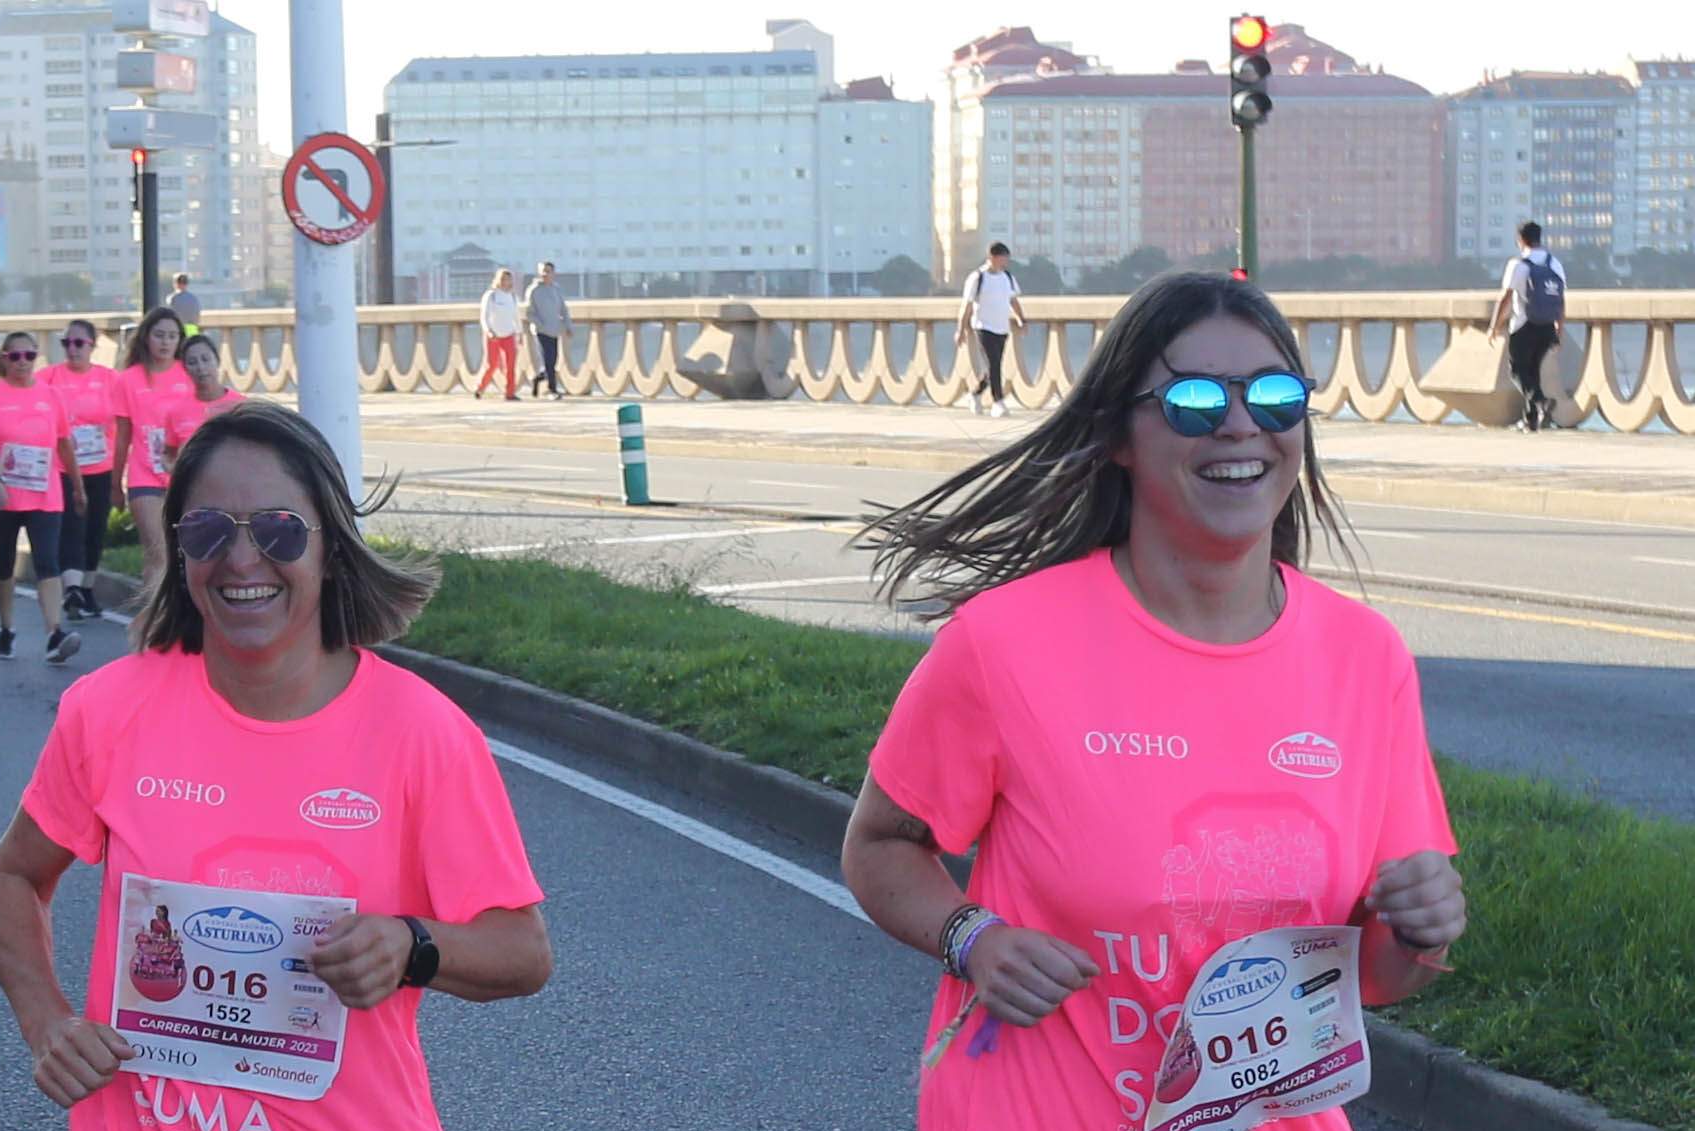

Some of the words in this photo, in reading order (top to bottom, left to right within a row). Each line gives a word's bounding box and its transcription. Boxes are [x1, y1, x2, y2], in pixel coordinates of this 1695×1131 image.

[1085, 731, 1189, 759] OYSHO
[136, 776, 225, 806] OYSHO
[305, 800, 375, 820] ASTURIANA
[191, 920, 275, 945] ASTURIANA
[292, 924, 326, 936] SUM
[1094, 930, 1168, 982] TU
[1292, 941, 1339, 959] SUMA
[192, 965, 268, 999] 016
[1197, 970, 1280, 1011] ASTURIANA
[205, 1003, 252, 1024] 1552
[139, 1017, 199, 1037] CARRERA
[201, 1027, 220, 1039] DE
[222, 1030, 239, 1043] LA
[241, 1033, 286, 1049] MUJER
[289, 1041, 319, 1054] 2023
[1207, 1016, 1288, 1064] 016
[130, 1043, 197, 1067] OYSHO
[253, 1062, 319, 1084] Santander
[1231, 1058, 1280, 1089] 6082
[1273, 1070, 1316, 1093] MUJER
[1319, 1056, 1347, 1074] 2023
[1284, 1080, 1353, 1109] Santander
